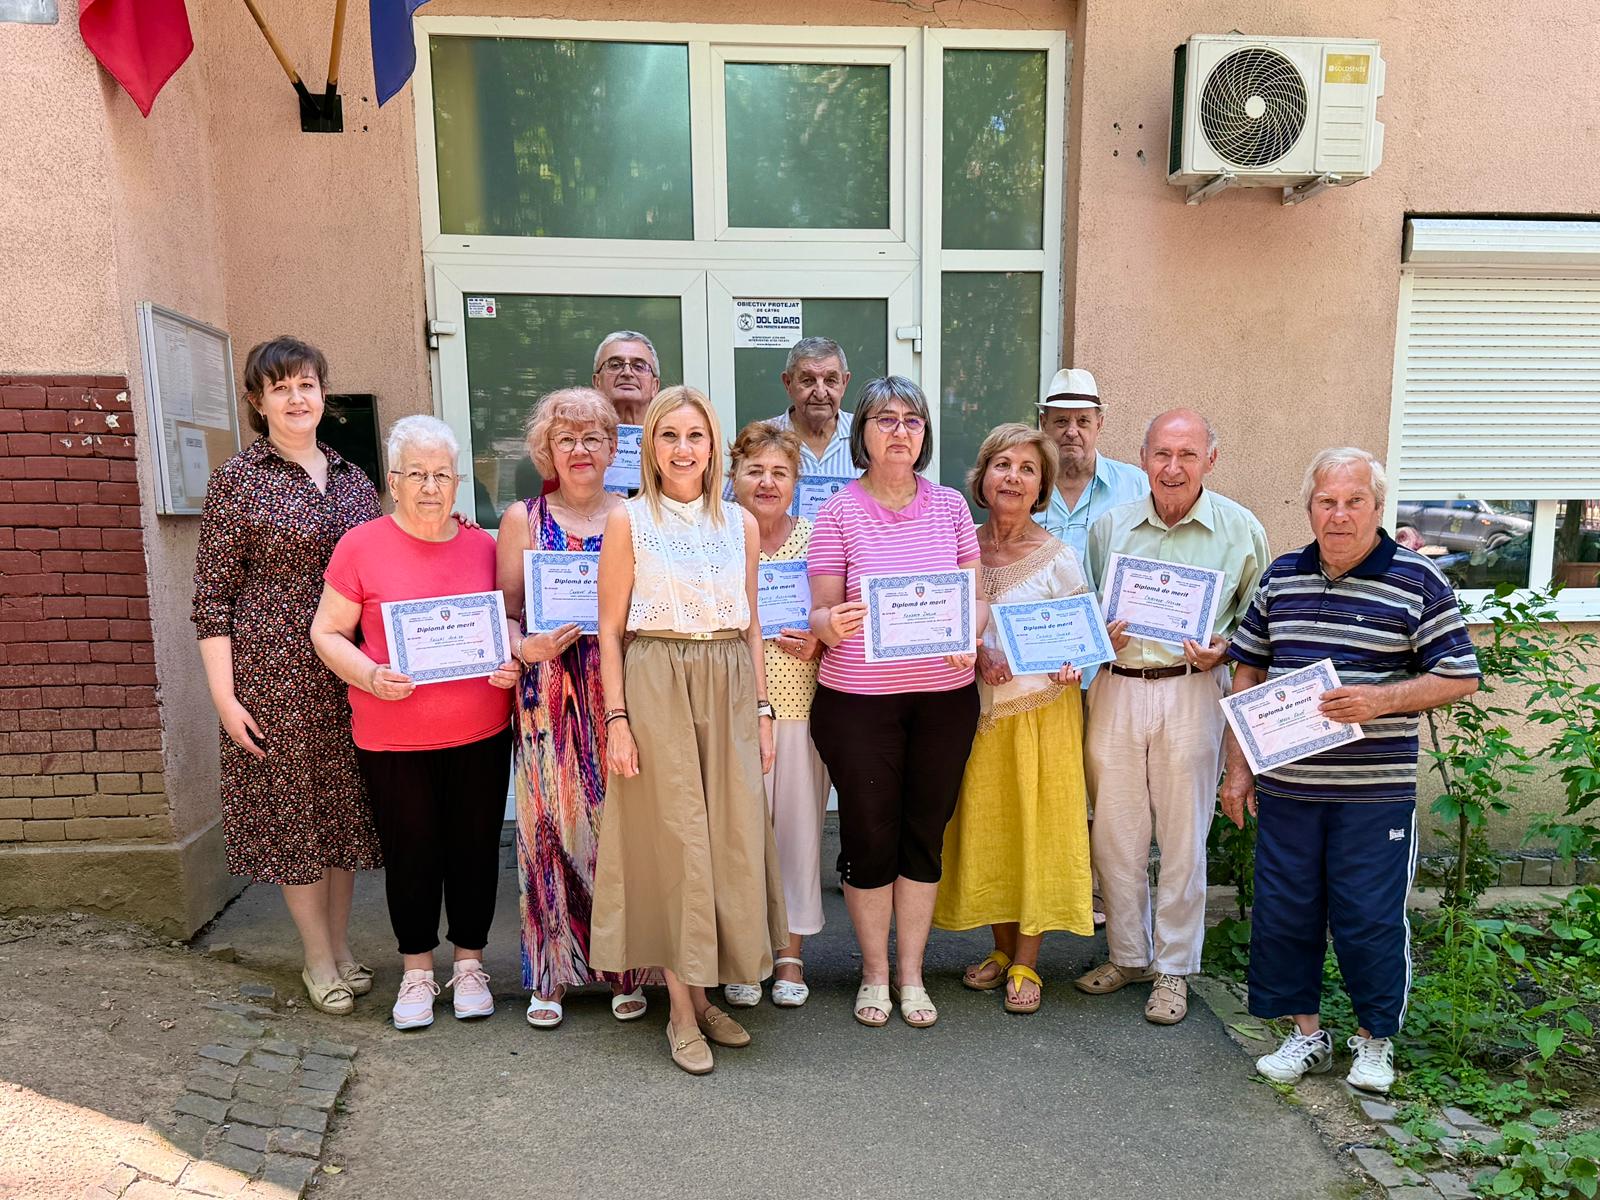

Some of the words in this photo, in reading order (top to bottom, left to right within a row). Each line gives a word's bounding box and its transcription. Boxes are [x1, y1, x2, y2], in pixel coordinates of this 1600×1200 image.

[756, 316, 772, 324] DOL
[772, 316, 800, 324] GUARD
[1134, 583, 1160, 592] Diplomă
[1171, 590, 1189, 598] merit
[891, 601, 918, 609] Diplomă
[416, 625, 445, 634] Diplomă
[456, 621, 475, 629] merit
[1023, 624, 1047, 632] Diplomă
[1258, 706, 1285, 720] Diplomă
[1285, 702, 1294, 710] de
[1294, 696, 1312, 706] merit
